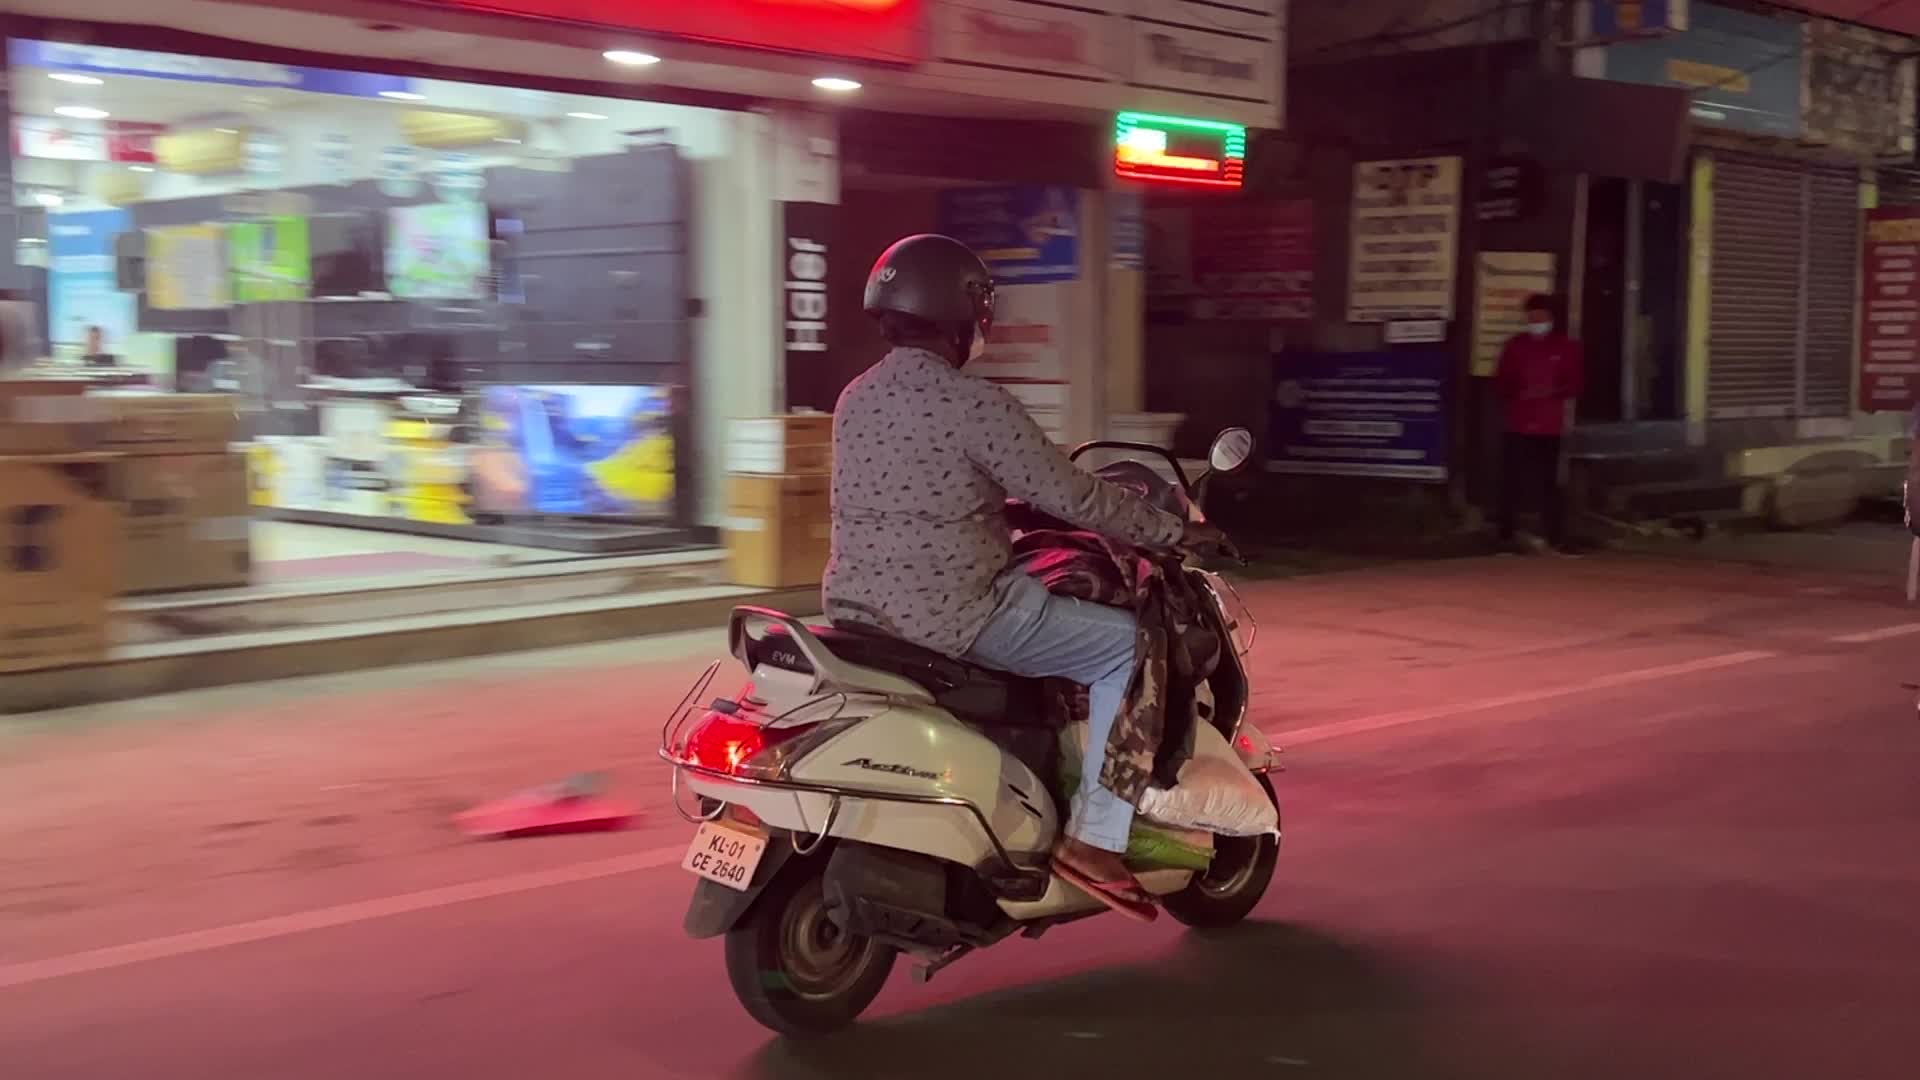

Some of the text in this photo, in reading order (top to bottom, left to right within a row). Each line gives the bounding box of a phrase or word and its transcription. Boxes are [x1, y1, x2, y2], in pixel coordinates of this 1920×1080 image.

[772, 650, 796, 665] EVM
[708, 833, 747, 859] KL-01
[691, 851, 746, 883] CE 2640
